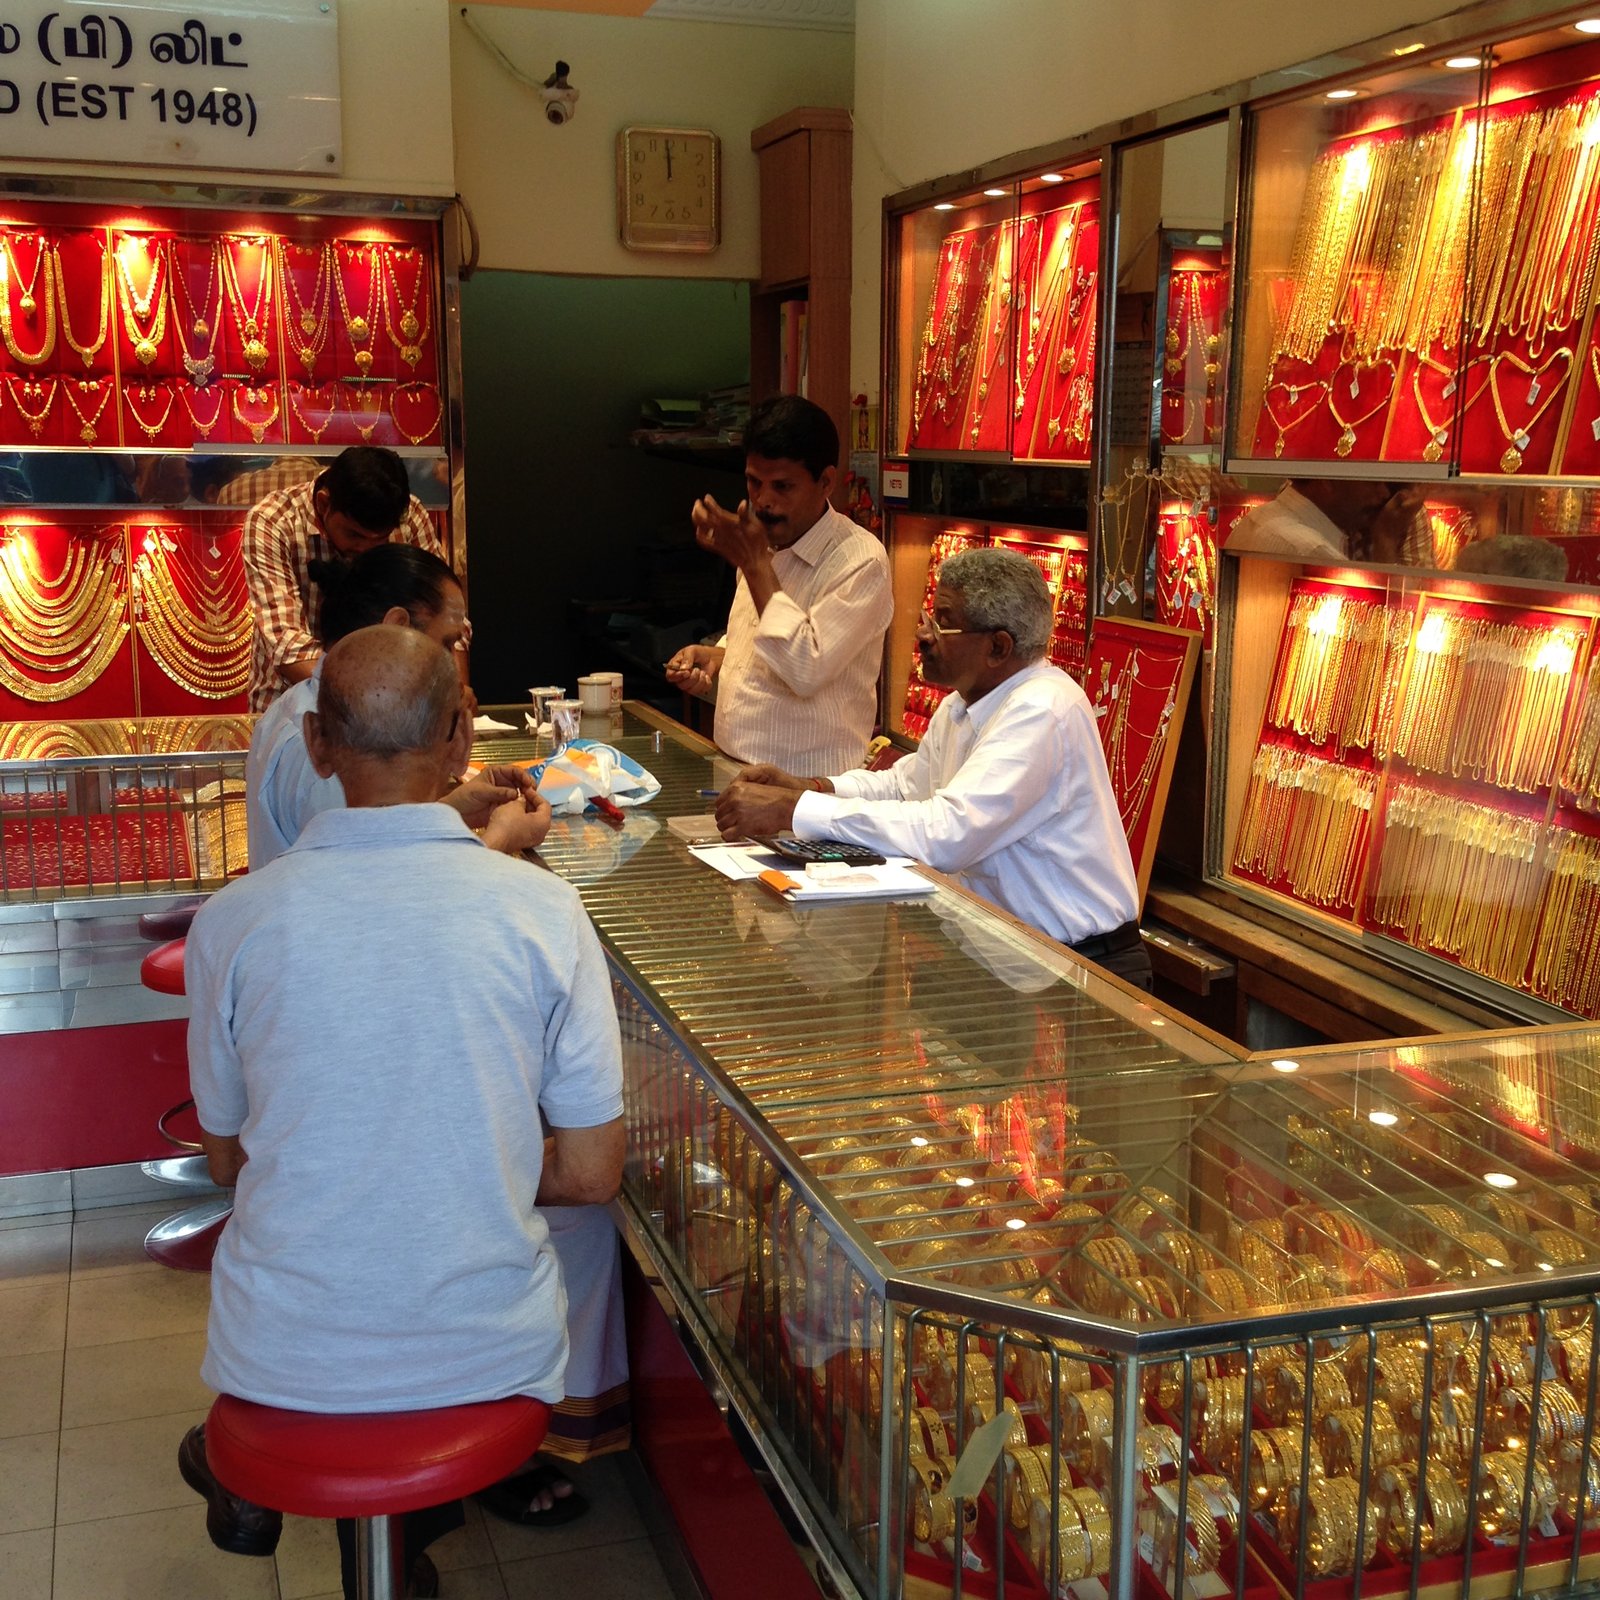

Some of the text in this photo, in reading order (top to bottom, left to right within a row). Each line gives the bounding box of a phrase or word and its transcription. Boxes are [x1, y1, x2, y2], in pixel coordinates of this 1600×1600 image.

[38, 13, 133, 69] (பி)
[150, 19, 248, 68] லிட்
[37, 81, 135, 126] (EST
[151, 88, 257, 137] 1948)
